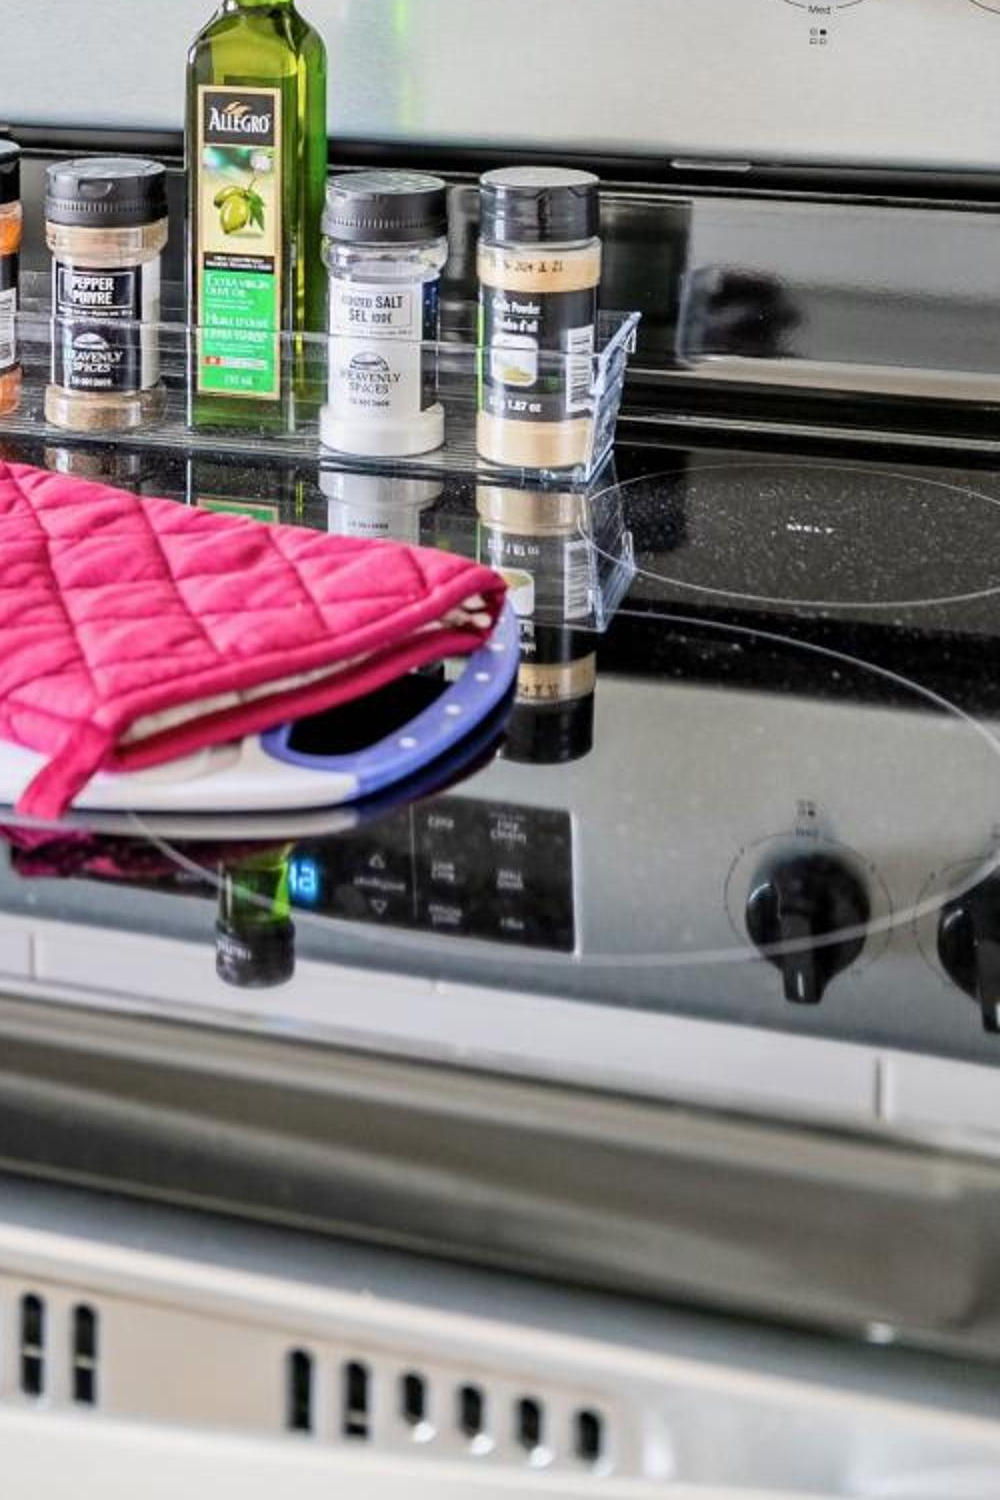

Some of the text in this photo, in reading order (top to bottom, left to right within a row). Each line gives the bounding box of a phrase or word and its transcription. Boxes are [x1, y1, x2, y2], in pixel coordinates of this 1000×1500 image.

[807, 4, 831, 15] Med
[208, 106, 270, 133] ALLEGRO
[71, 275, 114, 291] PEPPER
[72, 290, 113, 305] POIVRE
[375, 295, 404, 309] SALT
[511, 301, 541, 315] Powder
[348, 308, 368, 323] SEL
[71, 361, 112, 373] SPICES
[341, 369, 401, 384] HEAVENLY
[349, 381, 390, 394] SPICES
